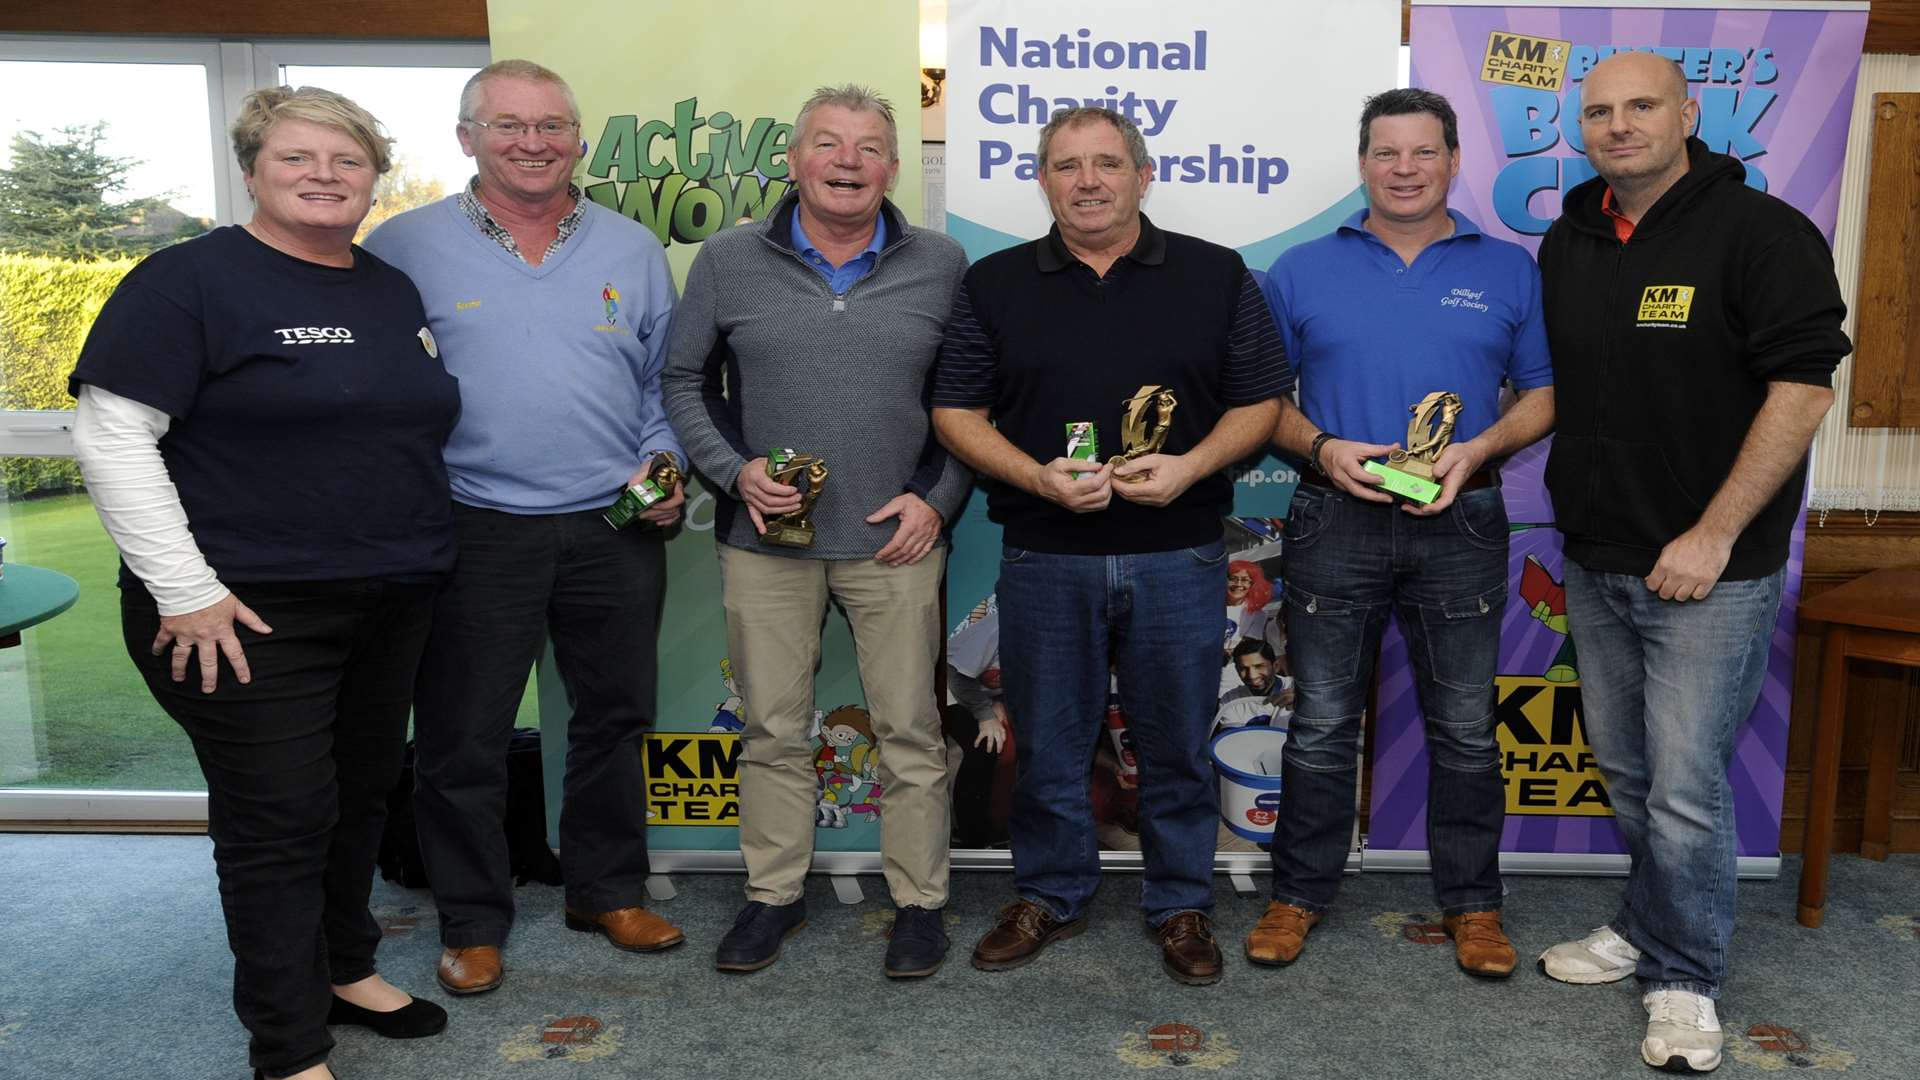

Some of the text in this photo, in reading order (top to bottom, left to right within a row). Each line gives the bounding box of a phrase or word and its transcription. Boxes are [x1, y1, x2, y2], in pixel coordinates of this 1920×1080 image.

[980, 26, 1208, 71] National
[1490, 34, 1548, 64] KM
[1488, 58, 1559, 75] CHARITY
[1572, 45, 1778, 84] BER'S
[1487, 67, 1557, 88] TEAM
[1489, 86, 1778, 161] BK
[587, 97, 795, 183] Active
[921, 156, 947, 166] GOL
[978, 140, 1289, 194] Parship
[1440, 297, 1488, 312] Golf Society
[1644, 288, 1679, 302] KM
[1641, 310, 1684, 319] TEAM
[273, 327, 353, 340] TESCO
[646, 738, 744, 779] KM
[649, 782, 740, 798] CHAR
[1503, 778, 1612, 808] EA
[650, 800, 740, 820] TEA
